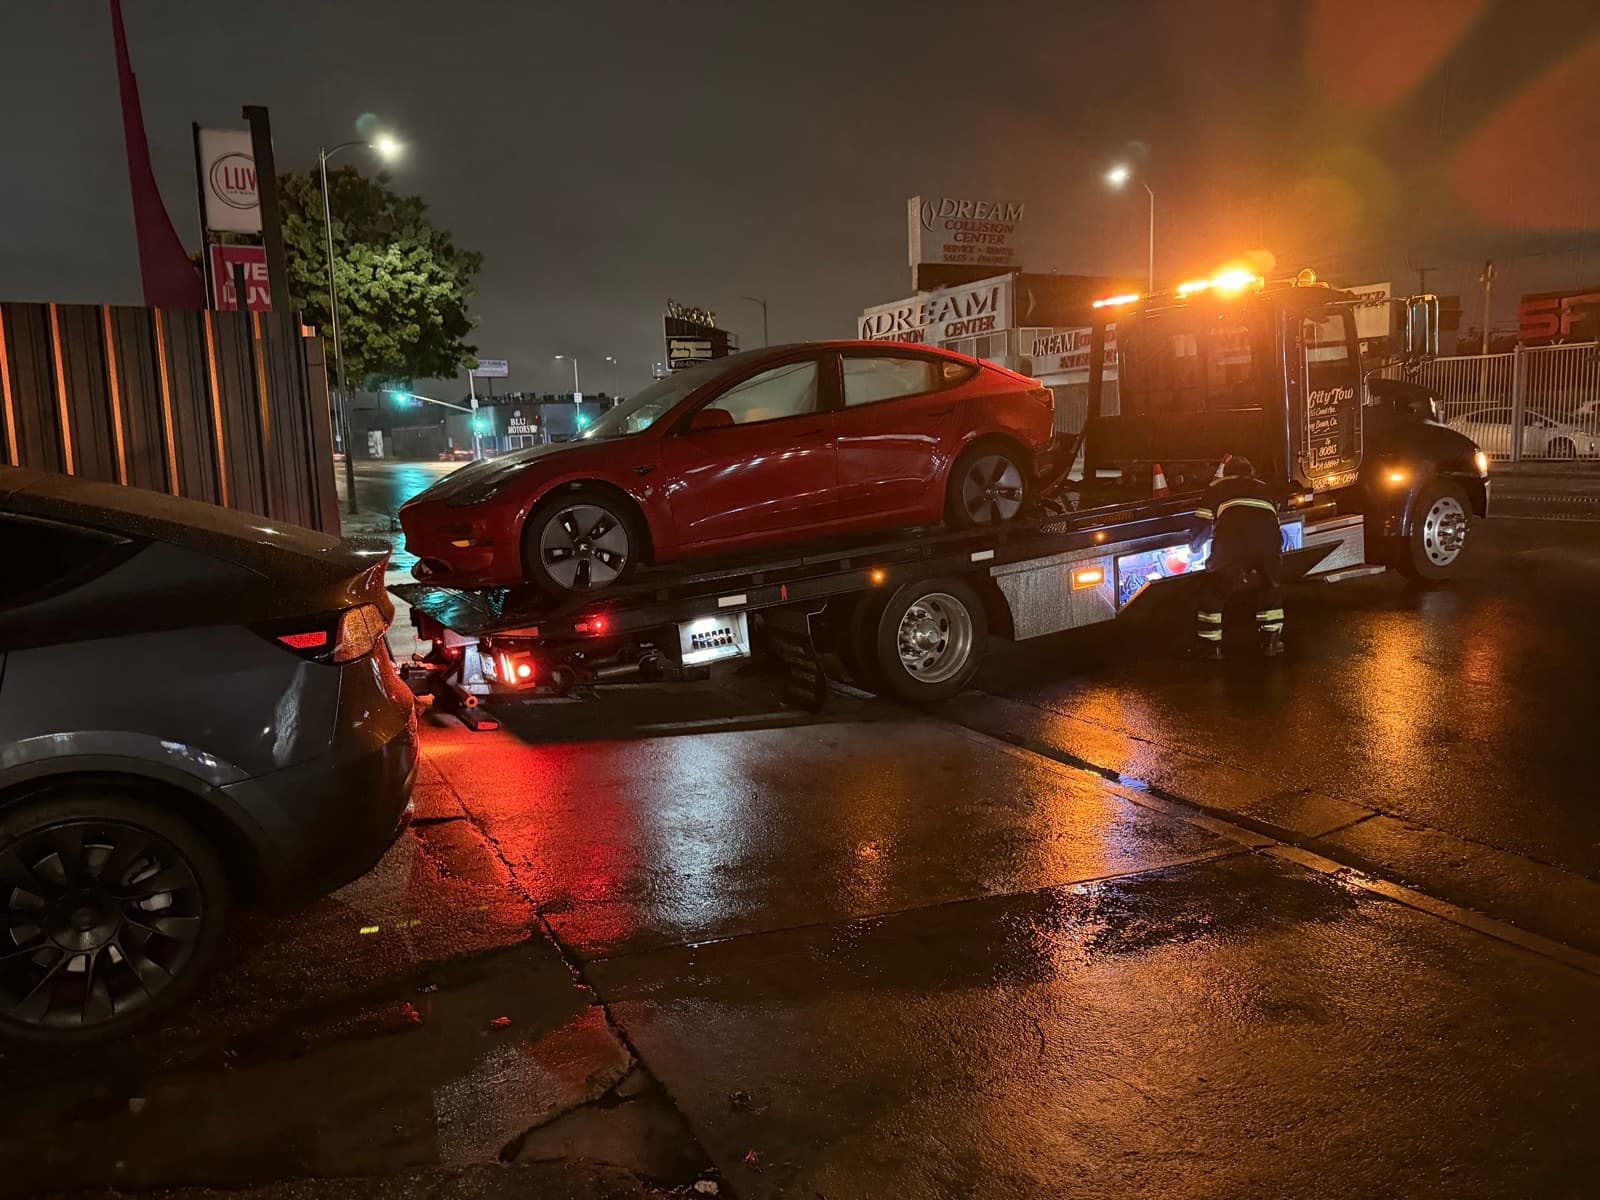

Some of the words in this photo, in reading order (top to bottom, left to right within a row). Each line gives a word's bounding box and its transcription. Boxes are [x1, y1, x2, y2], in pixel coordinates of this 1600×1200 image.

[224, 166, 256, 191] LUV
[938, 197, 1025, 222] DREAM
[944, 219, 1014, 234] COLLISION
[953, 231, 1006, 245] CENTER
[872, 287, 999, 336] DREAM
[945, 315, 995, 338] CENTER
[1032, 331, 1075, 358] DREAM
[1309, 390, 1332, 409] City
[1331, 386, 1353, 405] Tow
[508, 425, 530, 434] MOTORS
[510, 418, 526, 426] BLU
